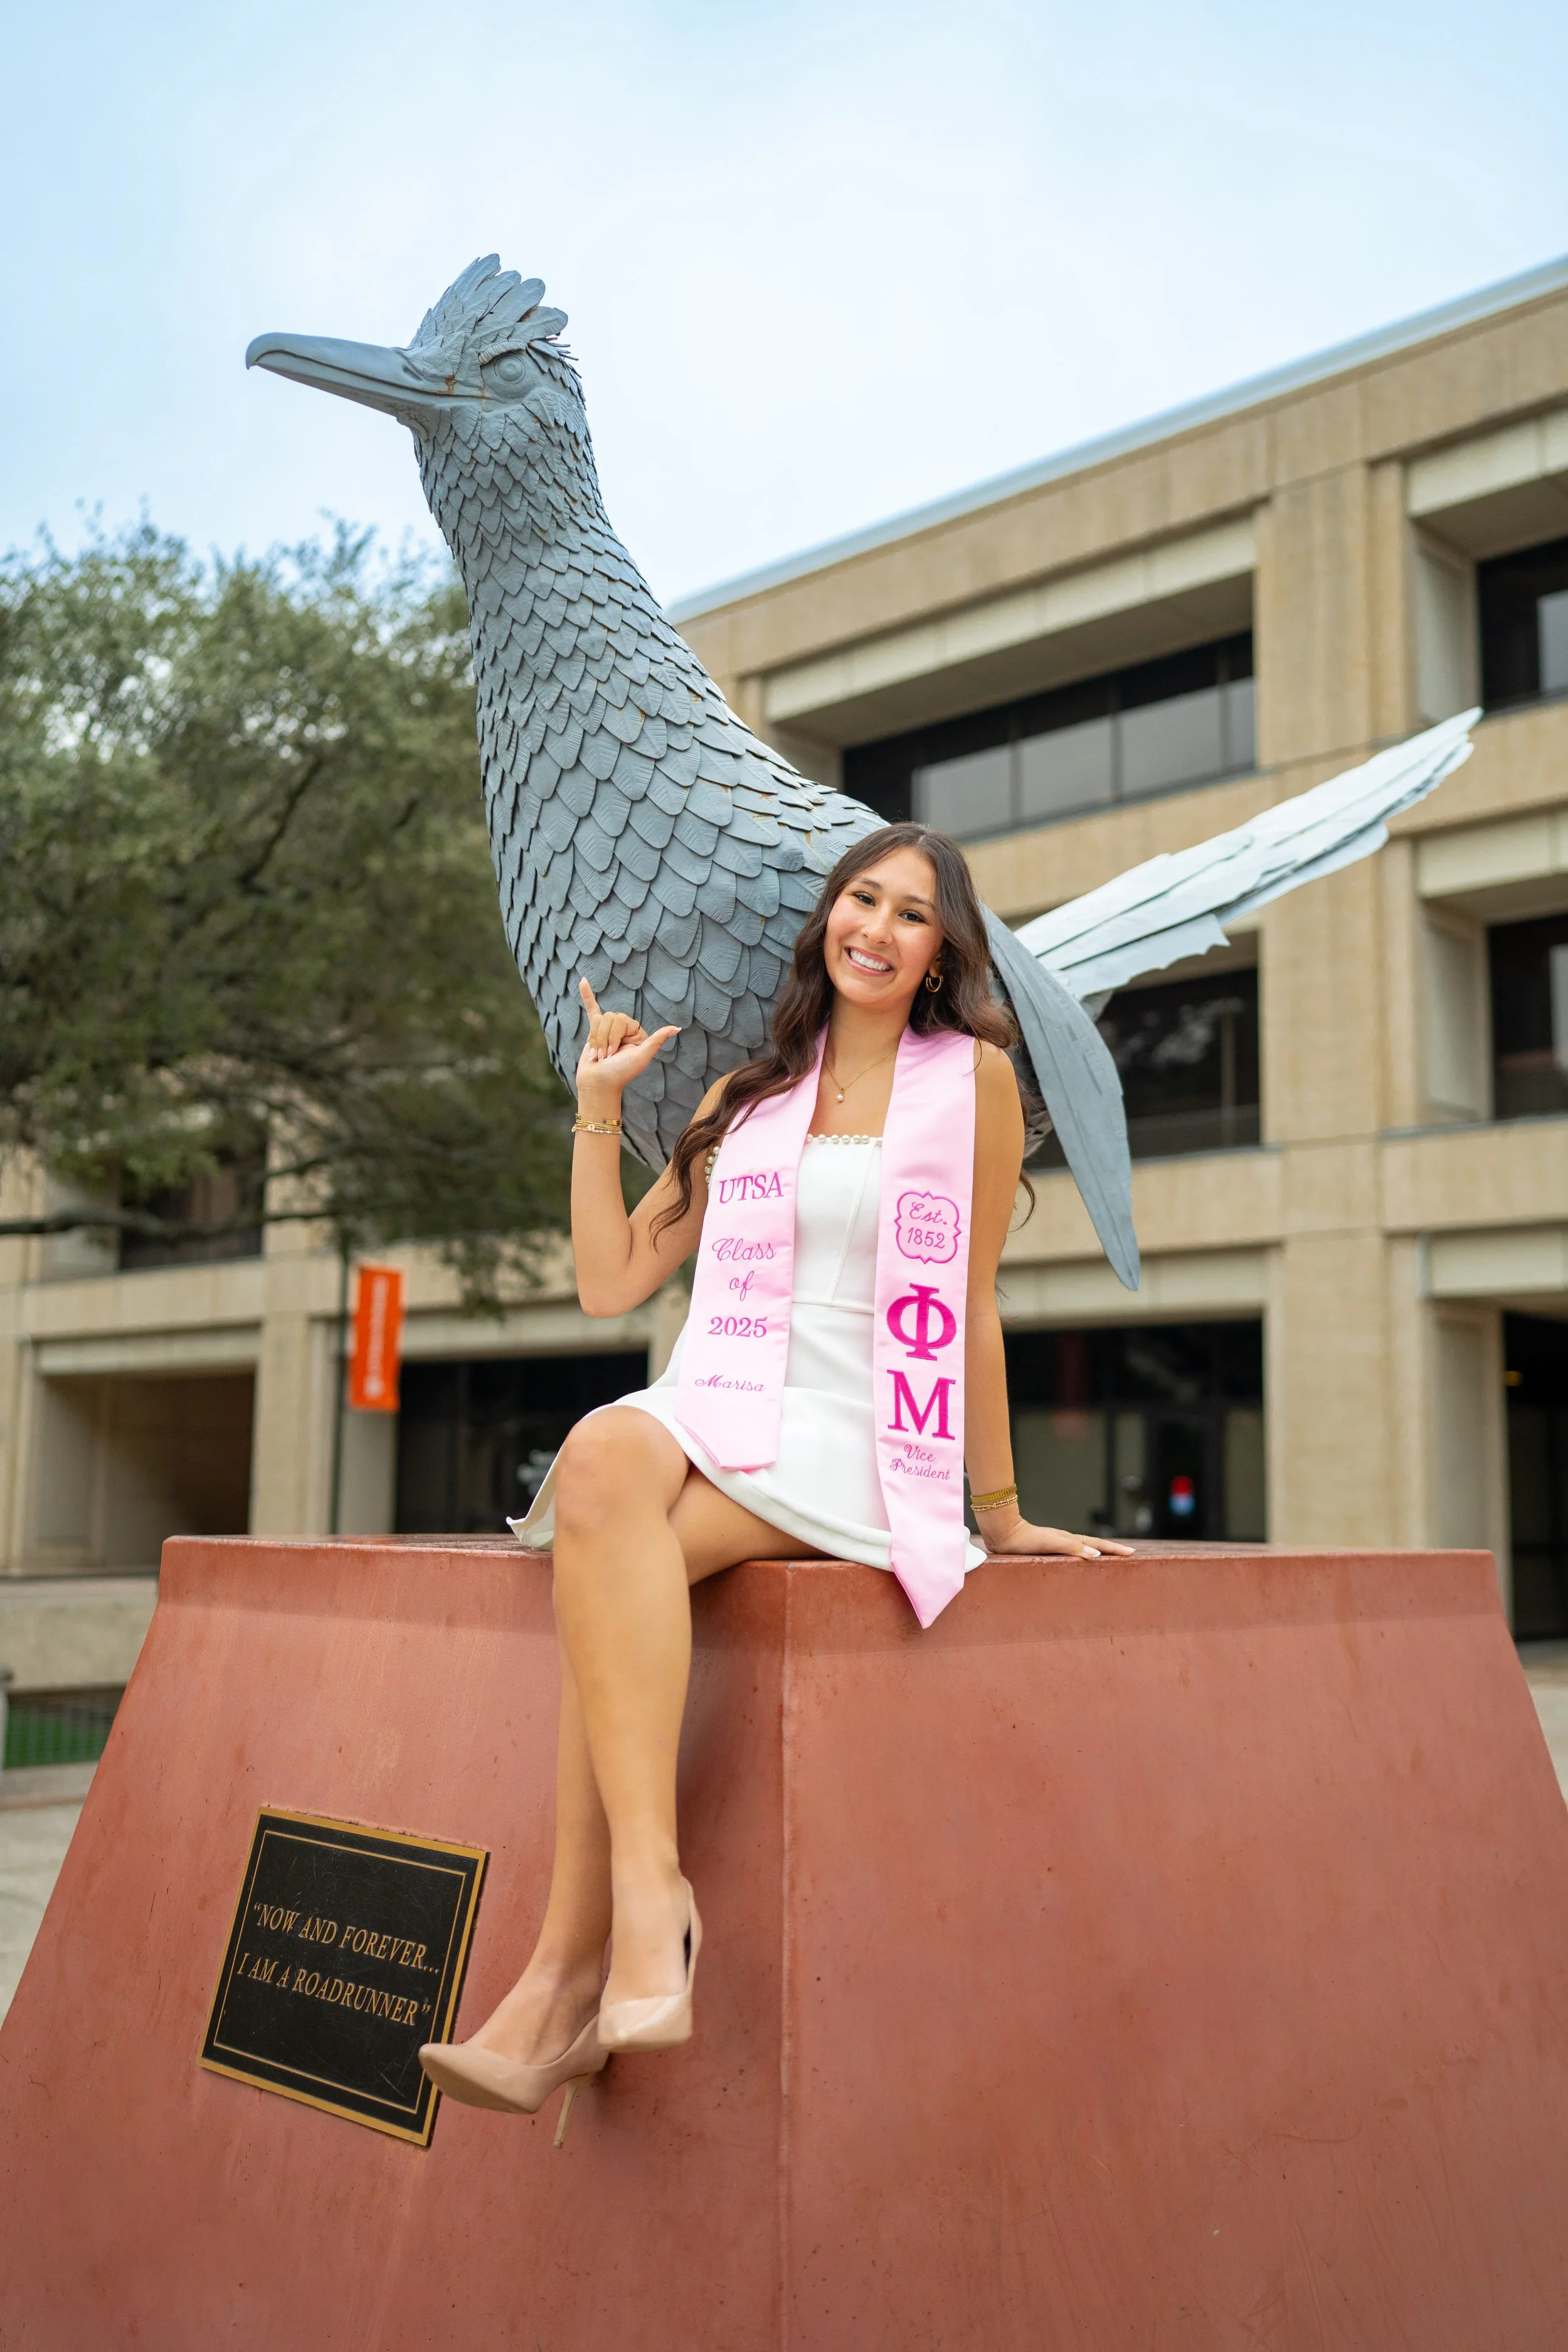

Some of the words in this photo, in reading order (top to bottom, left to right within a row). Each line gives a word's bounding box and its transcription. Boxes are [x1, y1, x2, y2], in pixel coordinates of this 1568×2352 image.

[719, 1172, 784, 1204] UTSA
[909, 1202, 947, 1225] Est.
[712, 1238, 776, 1261] Class
[908, 1227, 945, 1249] 1852
[729, 1271, 753, 1301] of
[707, 1316, 767, 1338] 2025
[886, 1283, 956, 1361] Φ
[695, 1375, 765, 1392] Marisa
[903, 1444, 936, 1463] Vice
[889, 1458, 951, 1481] President
[299, 1917, 337, 1944] AND
[236, 1952, 250, 1974] I
[248, 1959, 279, 1983] AM
[277, 1965, 292, 1988] A
